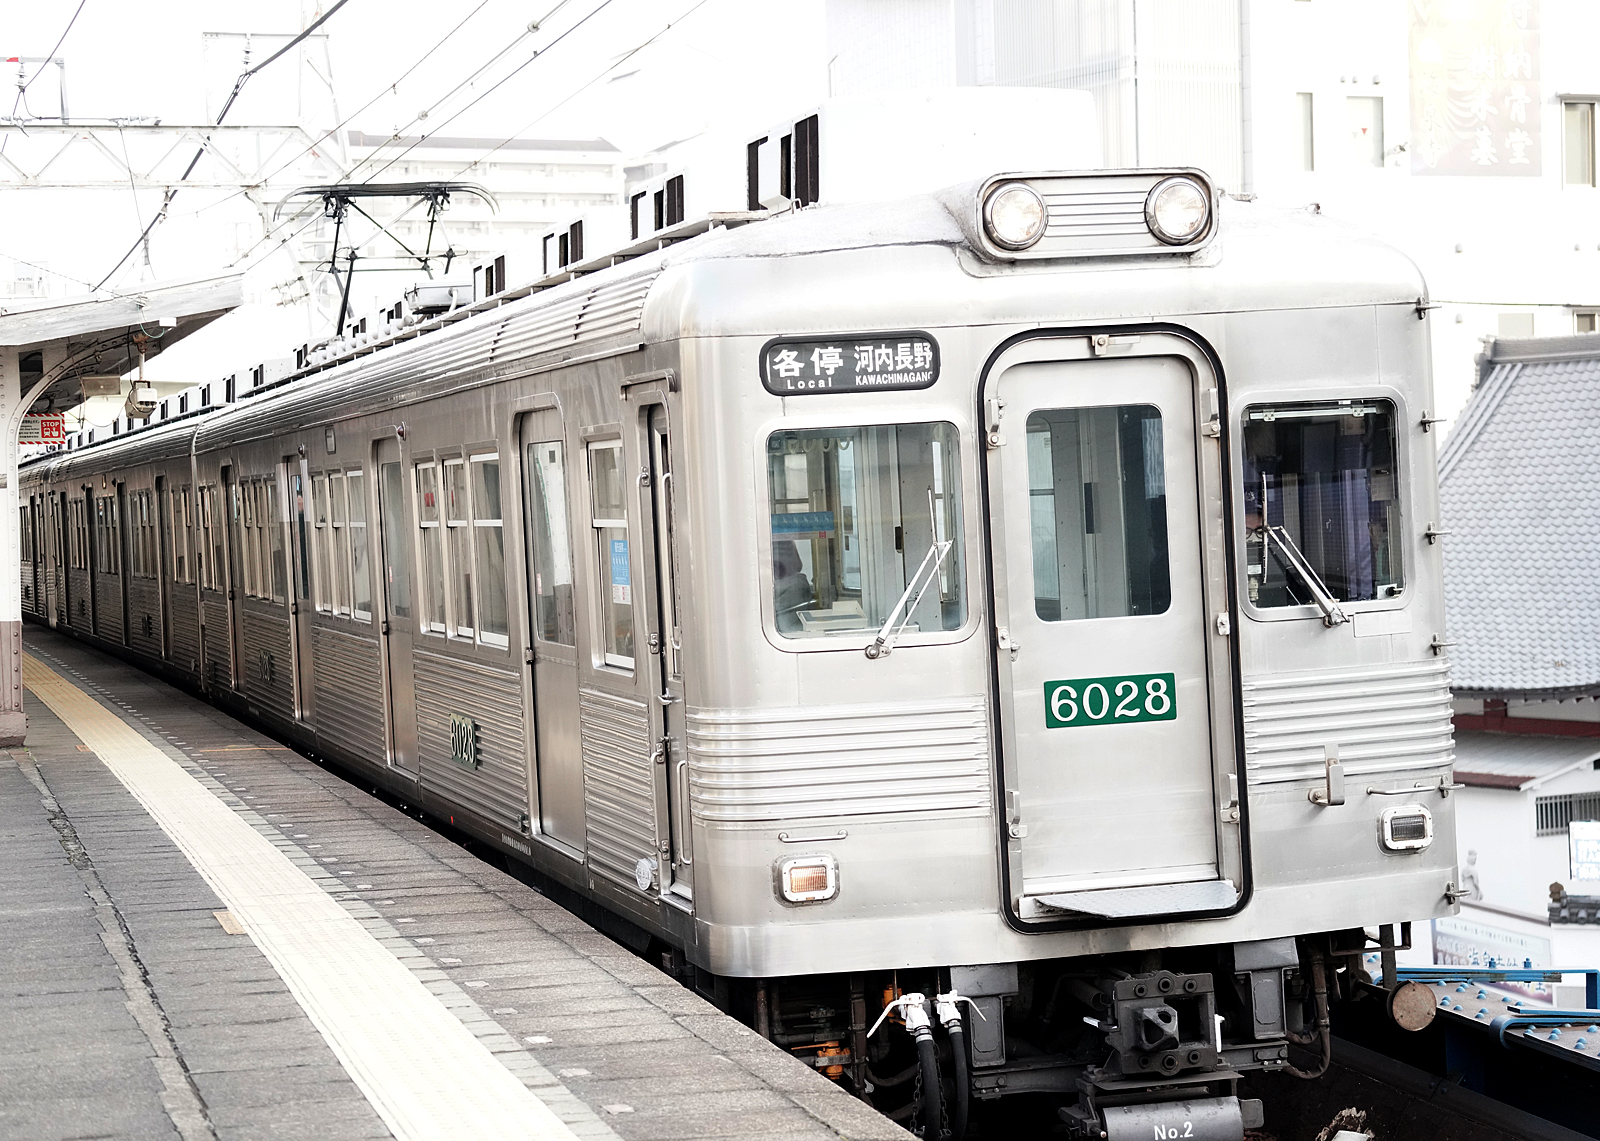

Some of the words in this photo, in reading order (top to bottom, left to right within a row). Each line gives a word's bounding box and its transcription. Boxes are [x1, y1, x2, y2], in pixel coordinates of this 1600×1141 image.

[772, 346, 844, 378] 各停
[853, 342, 933, 373] 河内長野
[787, 377, 832, 390] Local
[1051, 678, 1171, 722] 6028
[450, 718, 475, 764] 6028
[1154, 1121, 1194, 1141] No.2
